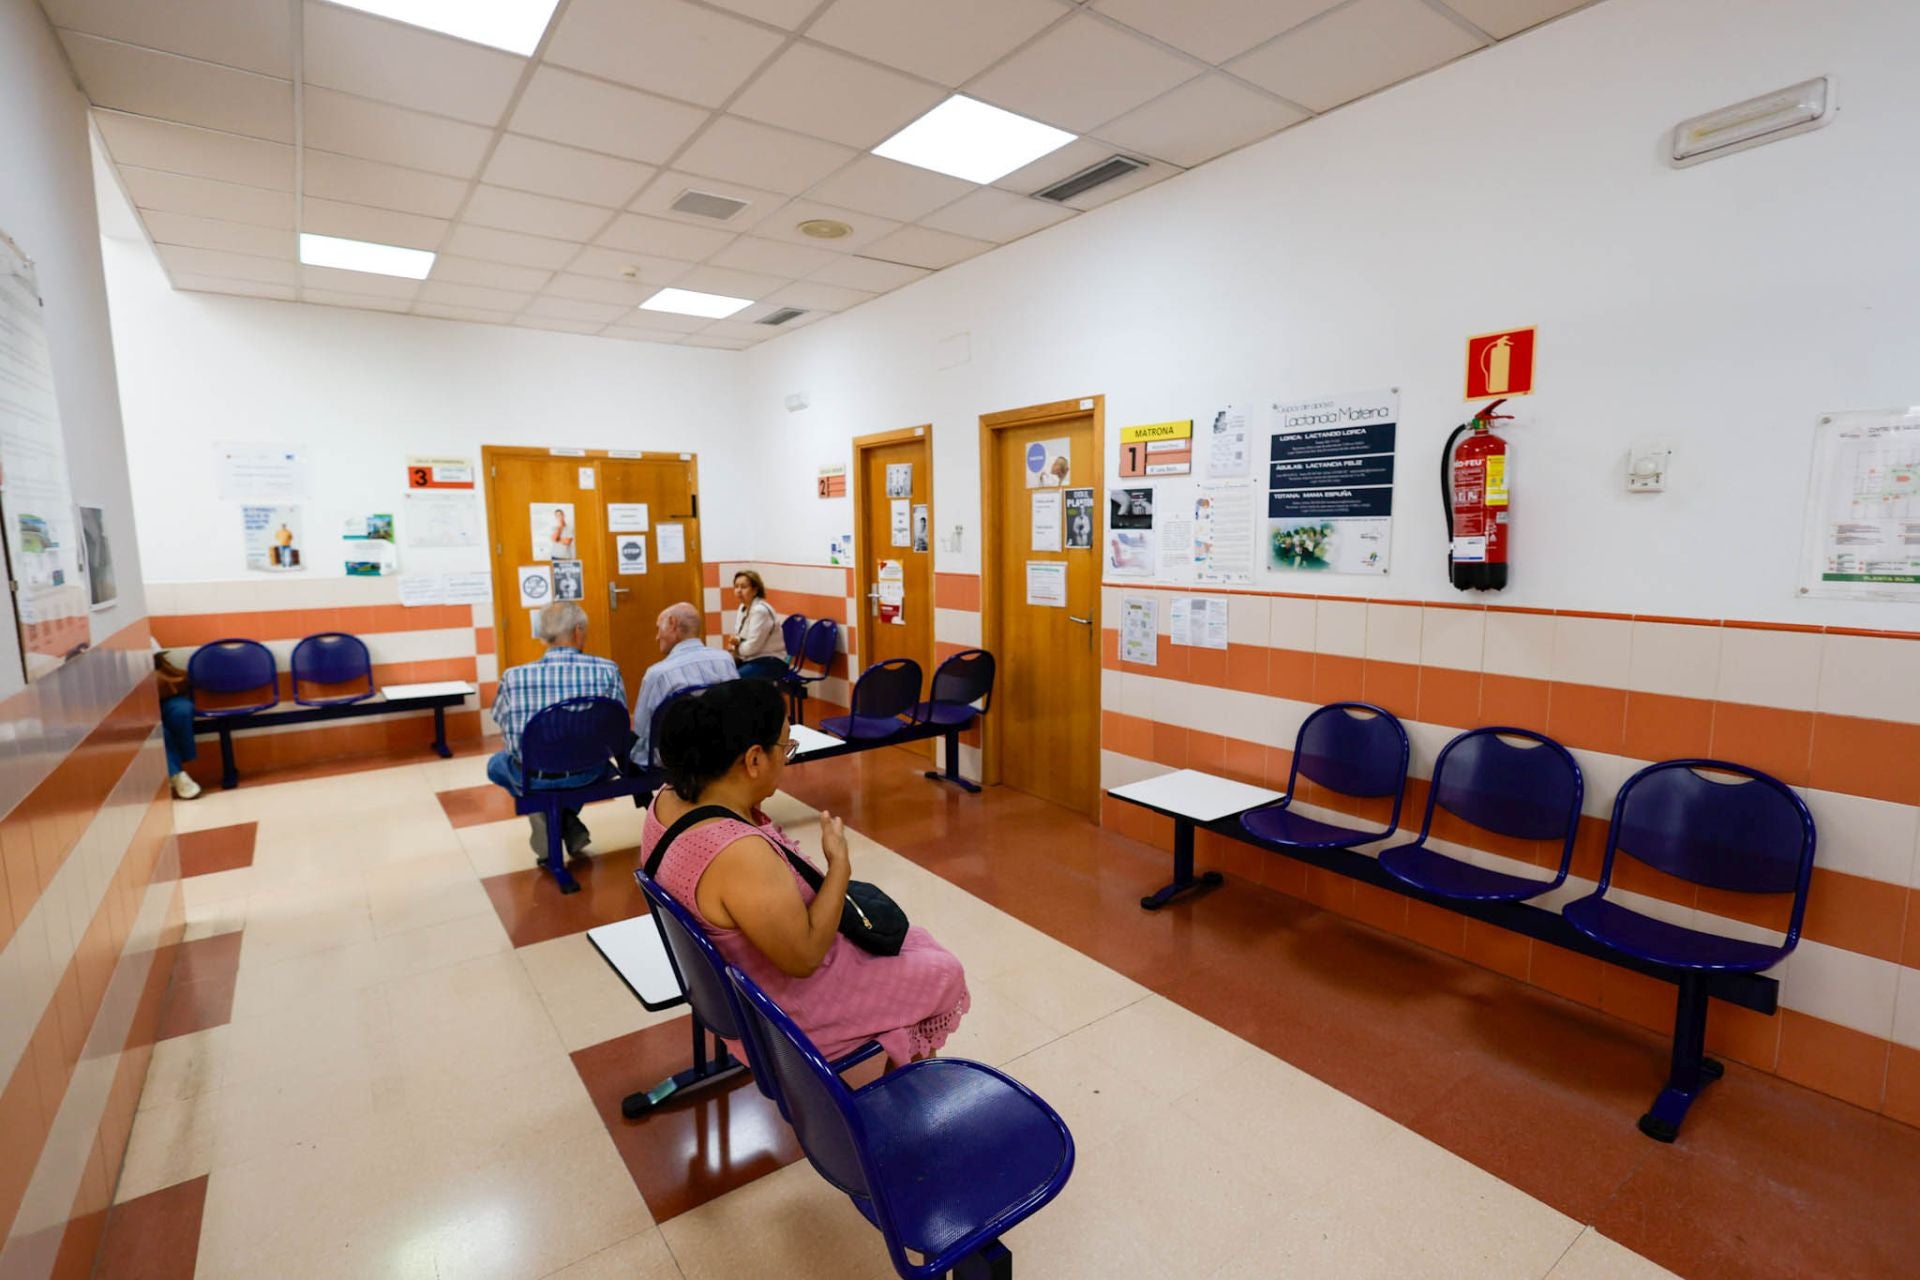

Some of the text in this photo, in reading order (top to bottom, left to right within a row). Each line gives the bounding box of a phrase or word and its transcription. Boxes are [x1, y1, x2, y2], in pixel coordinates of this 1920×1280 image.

[1284, 407, 1389, 428] Lactancia Materna
[1135, 426, 1174, 437] MATRONA
[1342, 428, 1367, 436] LORCA
[1128, 447, 1136, 472] 1
[414, 469, 428, 487] 3
[819, 479, 826, 496] 2
